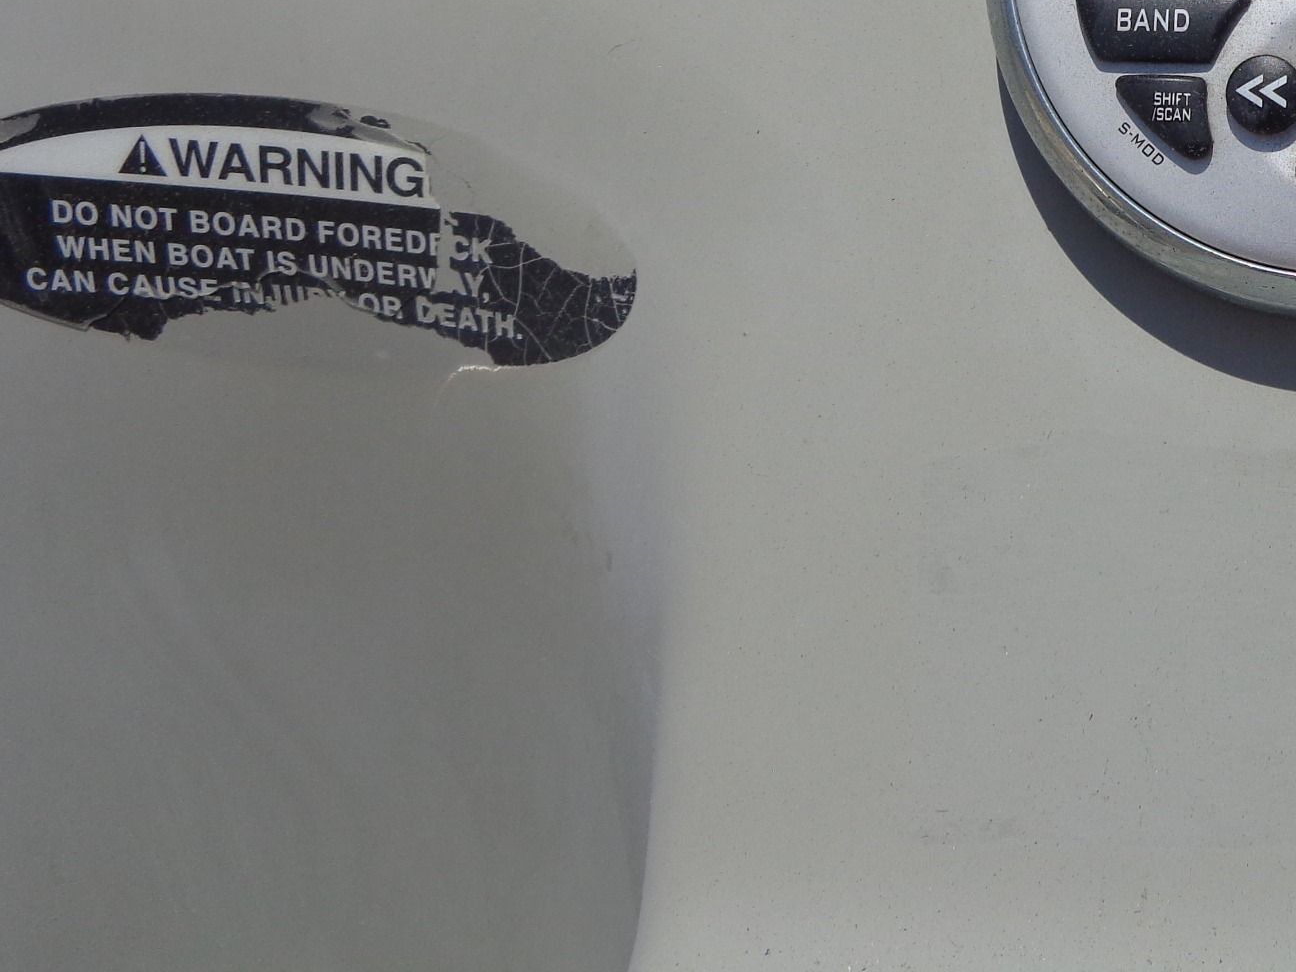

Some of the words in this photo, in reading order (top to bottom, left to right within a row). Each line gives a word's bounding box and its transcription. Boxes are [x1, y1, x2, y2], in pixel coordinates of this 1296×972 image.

[1117, 8, 1190, 32] BAND
[1154, 92, 1191, 106] SHIFT
[1118, 122, 1165, 166] S-MOD
[169, 137, 426, 199] WARNING
[52, 199, 99, 226] DO
[111, 204, 178, 231] NOT
[189, 210, 307, 242] BOARD
[56, 235, 157, 264] WHEN
[167, 242, 255, 271] BOAT
[266, 250, 297, 276] IS
[26, 267, 97, 294] CAN
[108, 272, 222, 301] CAUSE
[416, 295, 524, 340] DEATH.
